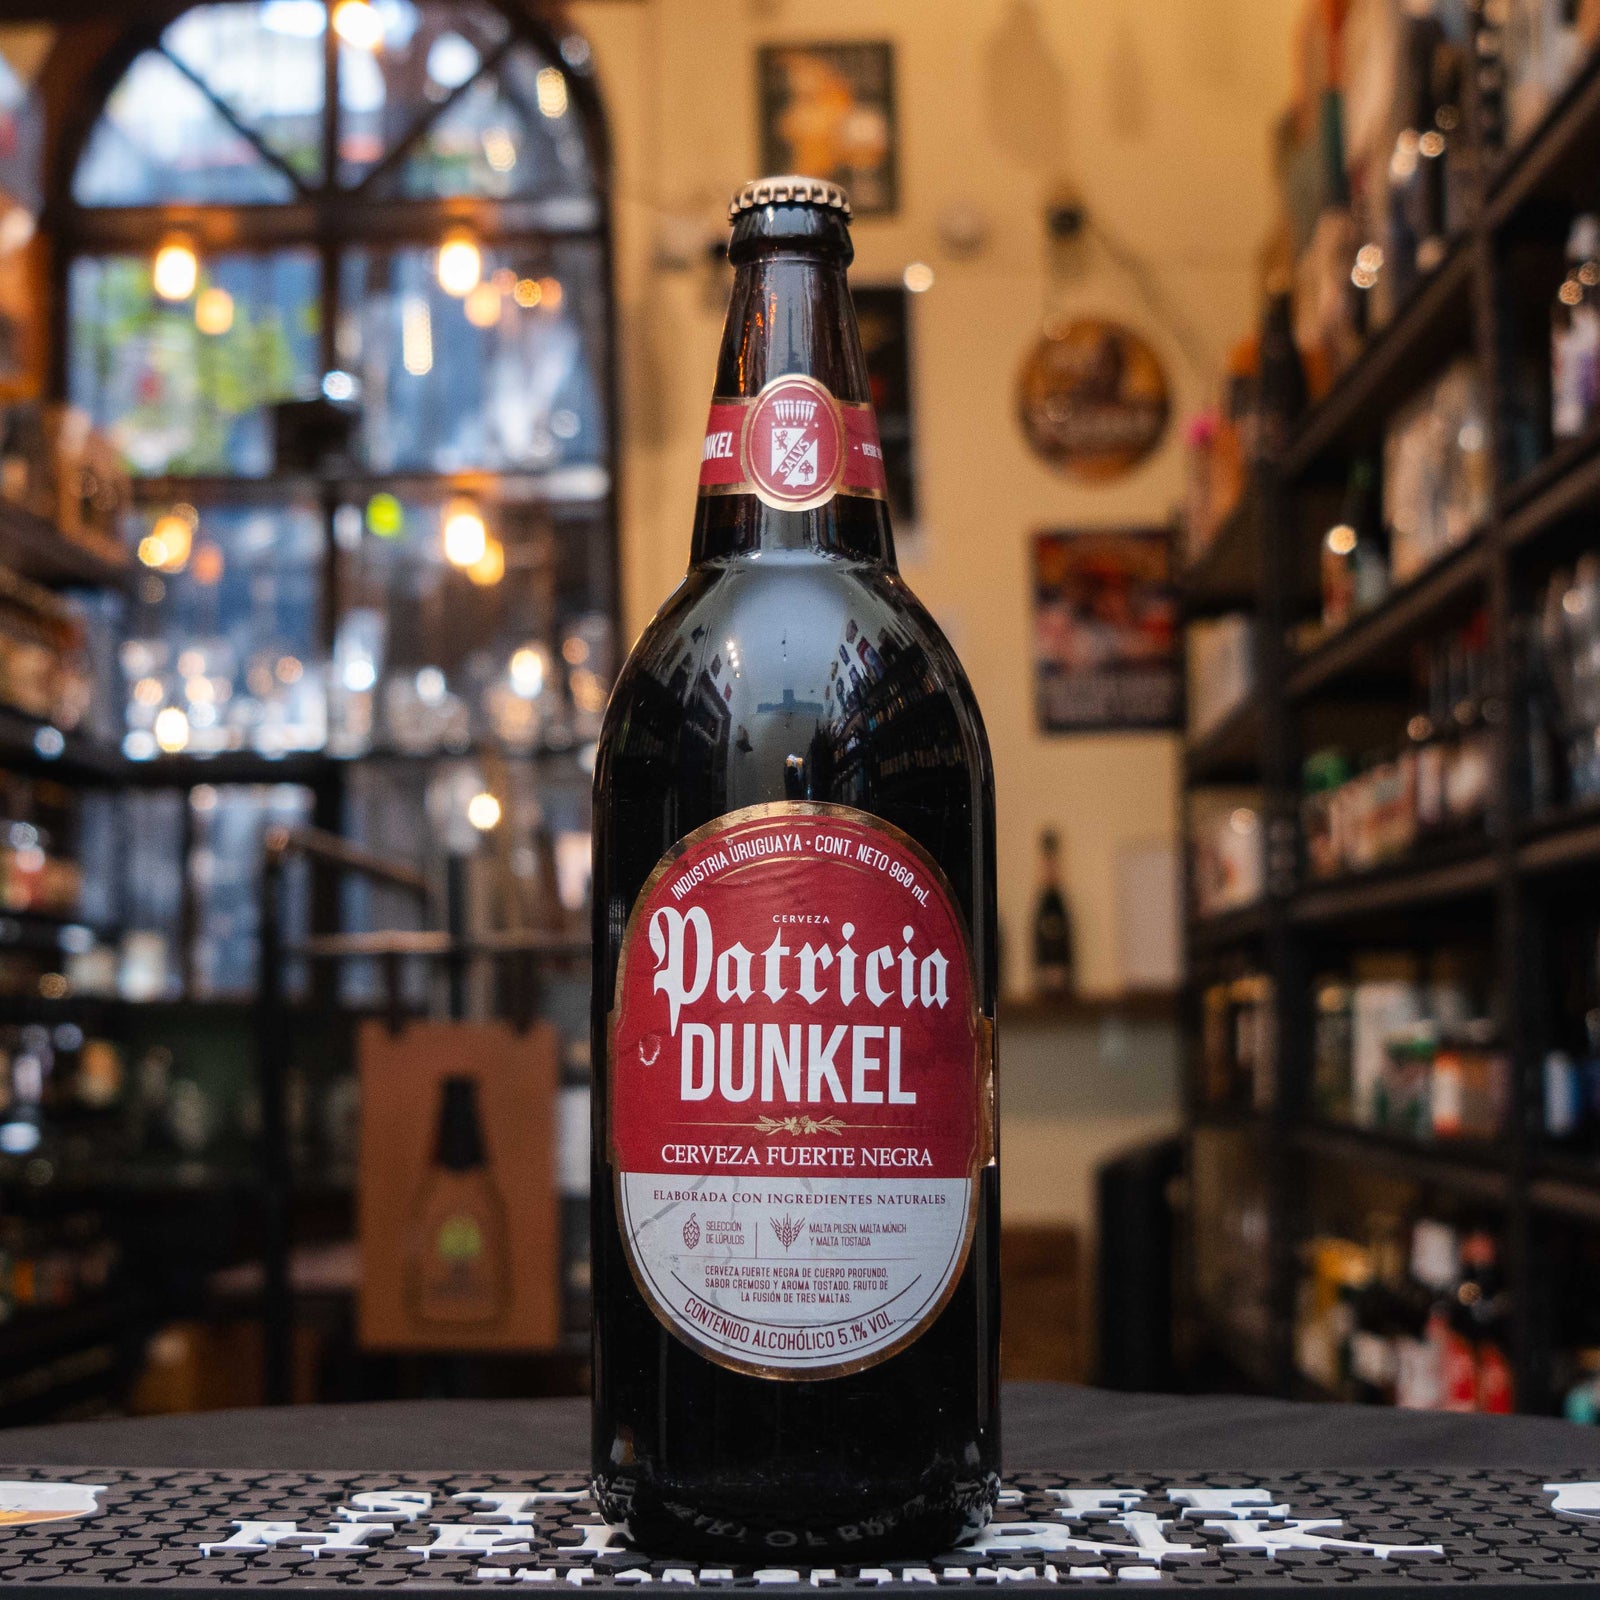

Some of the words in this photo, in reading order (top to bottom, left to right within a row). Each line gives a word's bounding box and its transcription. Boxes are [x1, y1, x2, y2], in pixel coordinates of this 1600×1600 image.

[702, 432, 733, 462] NKEL
[778, 438, 810, 477] SALVS
[671, 851, 729, 901] INDUSTRIA
[729, 834, 802, 863] URUGUAYA
[815, 835, 852, 858] CONT.
[856, 844, 889, 871] NETO
[889, 861, 914, 888] 960
[772, 914, 831, 924] CERVEZA
[649, 906, 950, 1037] Patricia
[681, 1023, 916, 1104] DUNKEL
[661, 1144, 760, 1165] CERVEZA
[766, 1146, 855, 1167] FUERTE
[860, 1148, 933, 1167] NEGRA
[653, 1190, 727, 1202] ELABORADA
[732, 1192, 762, 1203] CON
[767, 1193, 873, 1205] INGREDIENTES
[877, 1194, 946, 1205] NATURALES
[705, 1220, 742, 1232] SELECCIÓN
[809, 1223, 832, 1234] MALTA
[859, 1223, 881, 1234] MALTA
[705, 1233, 715, 1244] DE
[715, 1232, 745, 1245] LÚPULOS
[809, 1236, 815, 1246] Y
[816, 1236, 839, 1247] MALTA
[841, 1236, 871, 1247] TOSTADA
[705, 1265, 739, 1276] CERVEZA
[741, 1266, 770, 1277] FUERTE
[773, 1267, 800, 1278] NEGRA
[802, 1267, 811, 1278] DE
[814, 1267, 845, 1278] CUERPO
[705, 1278, 730, 1289] SABOR
[732, 1279, 771, 1290] CREMOSO
[773, 1280, 779, 1290] Y
[781, 1280, 810, 1290] AROMA
[853, 1280, 877, 1290] FRUTO
[879, 1280, 888, 1290] DE
[740, 1291, 750, 1302] LA
[752, 1290, 781, 1303] FUSIÓN
[783, 1292, 793, 1303] DE
[796, 1293, 816, 1304] TRES
[684, 1297, 750, 1343] CONTENIDO
[752, 1329, 835, 1351] ALCOHÓLICO
[837, 1324, 868, 1346] 5.1%
[868, 1311, 897, 1334] VOL.
